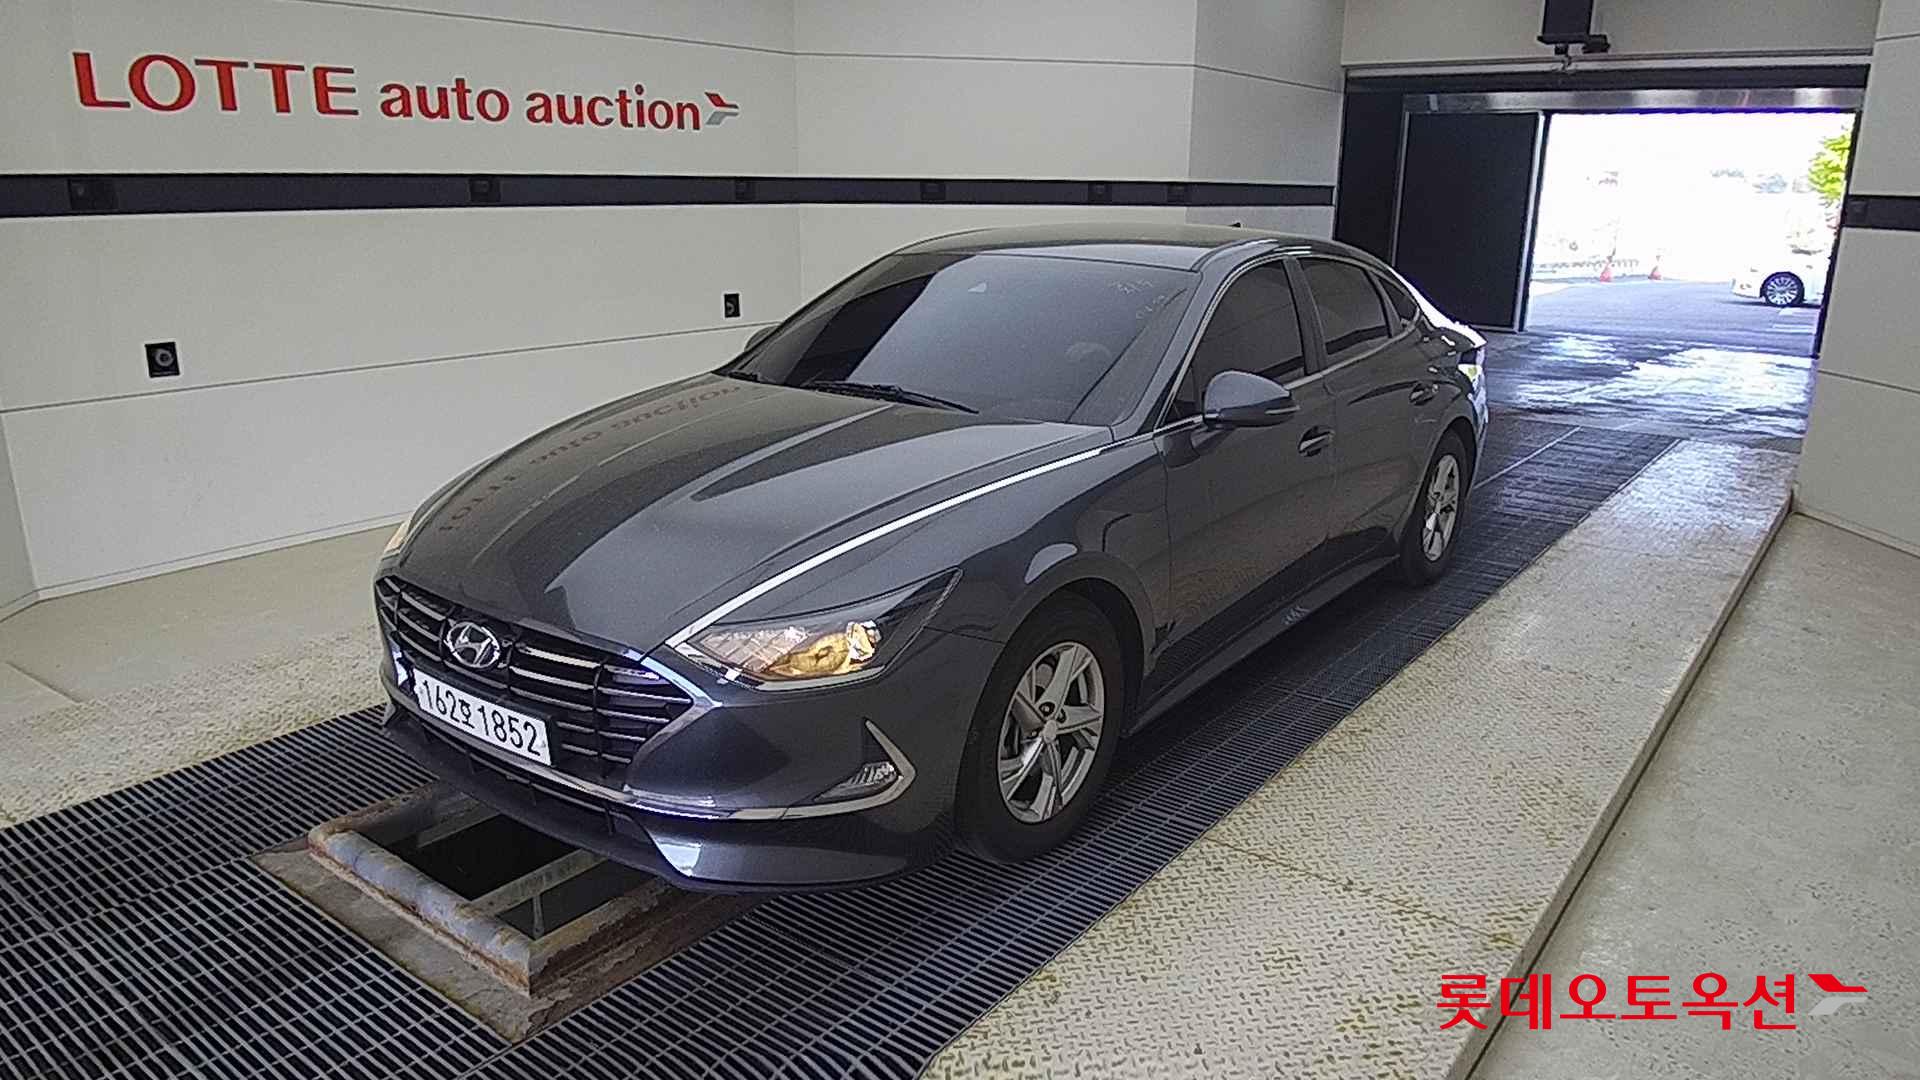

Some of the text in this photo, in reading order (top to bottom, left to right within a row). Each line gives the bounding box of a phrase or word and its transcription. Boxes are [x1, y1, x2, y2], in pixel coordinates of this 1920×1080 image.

[72, 51, 701, 131] LOTTE auto auction
